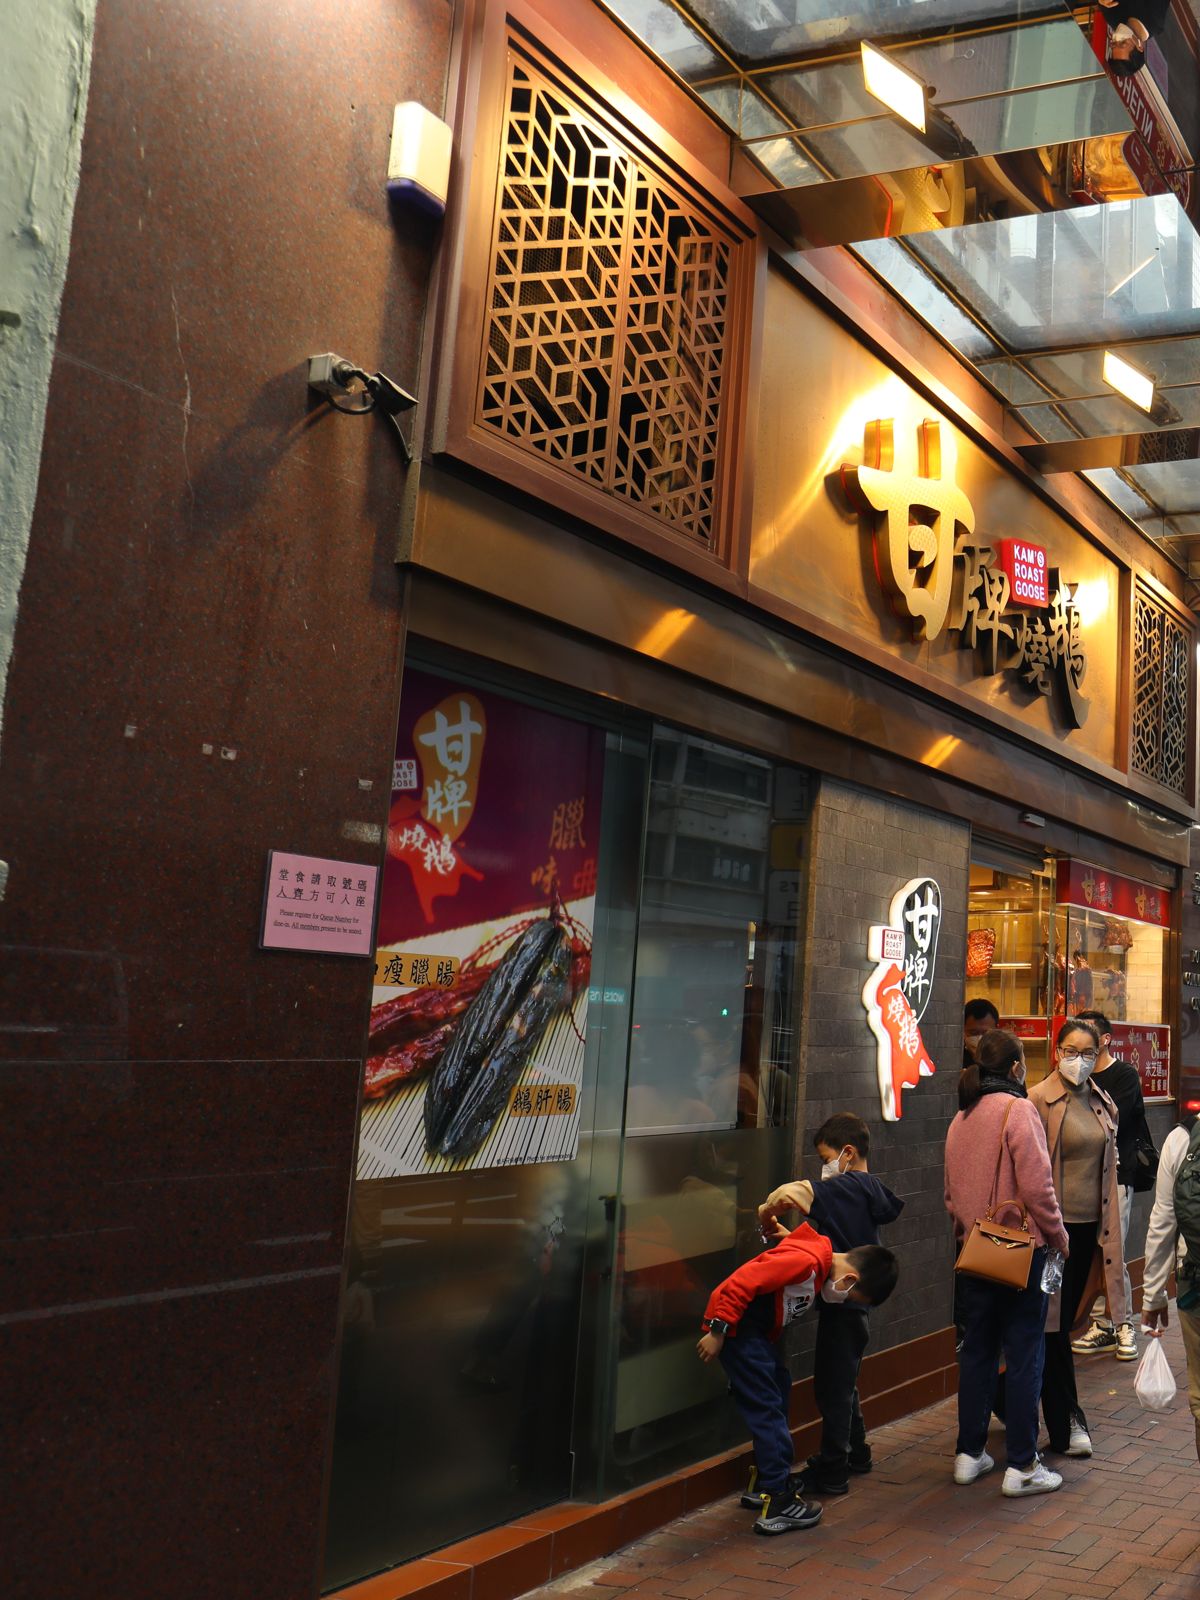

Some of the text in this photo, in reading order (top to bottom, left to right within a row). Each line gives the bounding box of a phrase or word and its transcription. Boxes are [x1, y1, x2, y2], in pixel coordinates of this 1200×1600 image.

[1014, 545, 1045, 567] KAM'S
[843, 418, 1092, 729] 甘牌燒鵝
[1014, 562, 1044, 583] ROAST
[1015, 580, 1045, 601] GOOSE
[279, 868, 367, 892] 堂食請取號碼
[276, 885, 365, 907] 人齊方可入座
[905, 886, 938, 1003] 甘牌
[374, 954, 455, 987] 瘦臘腸
[512, 1087, 572, 1113] 鵝肝腸
